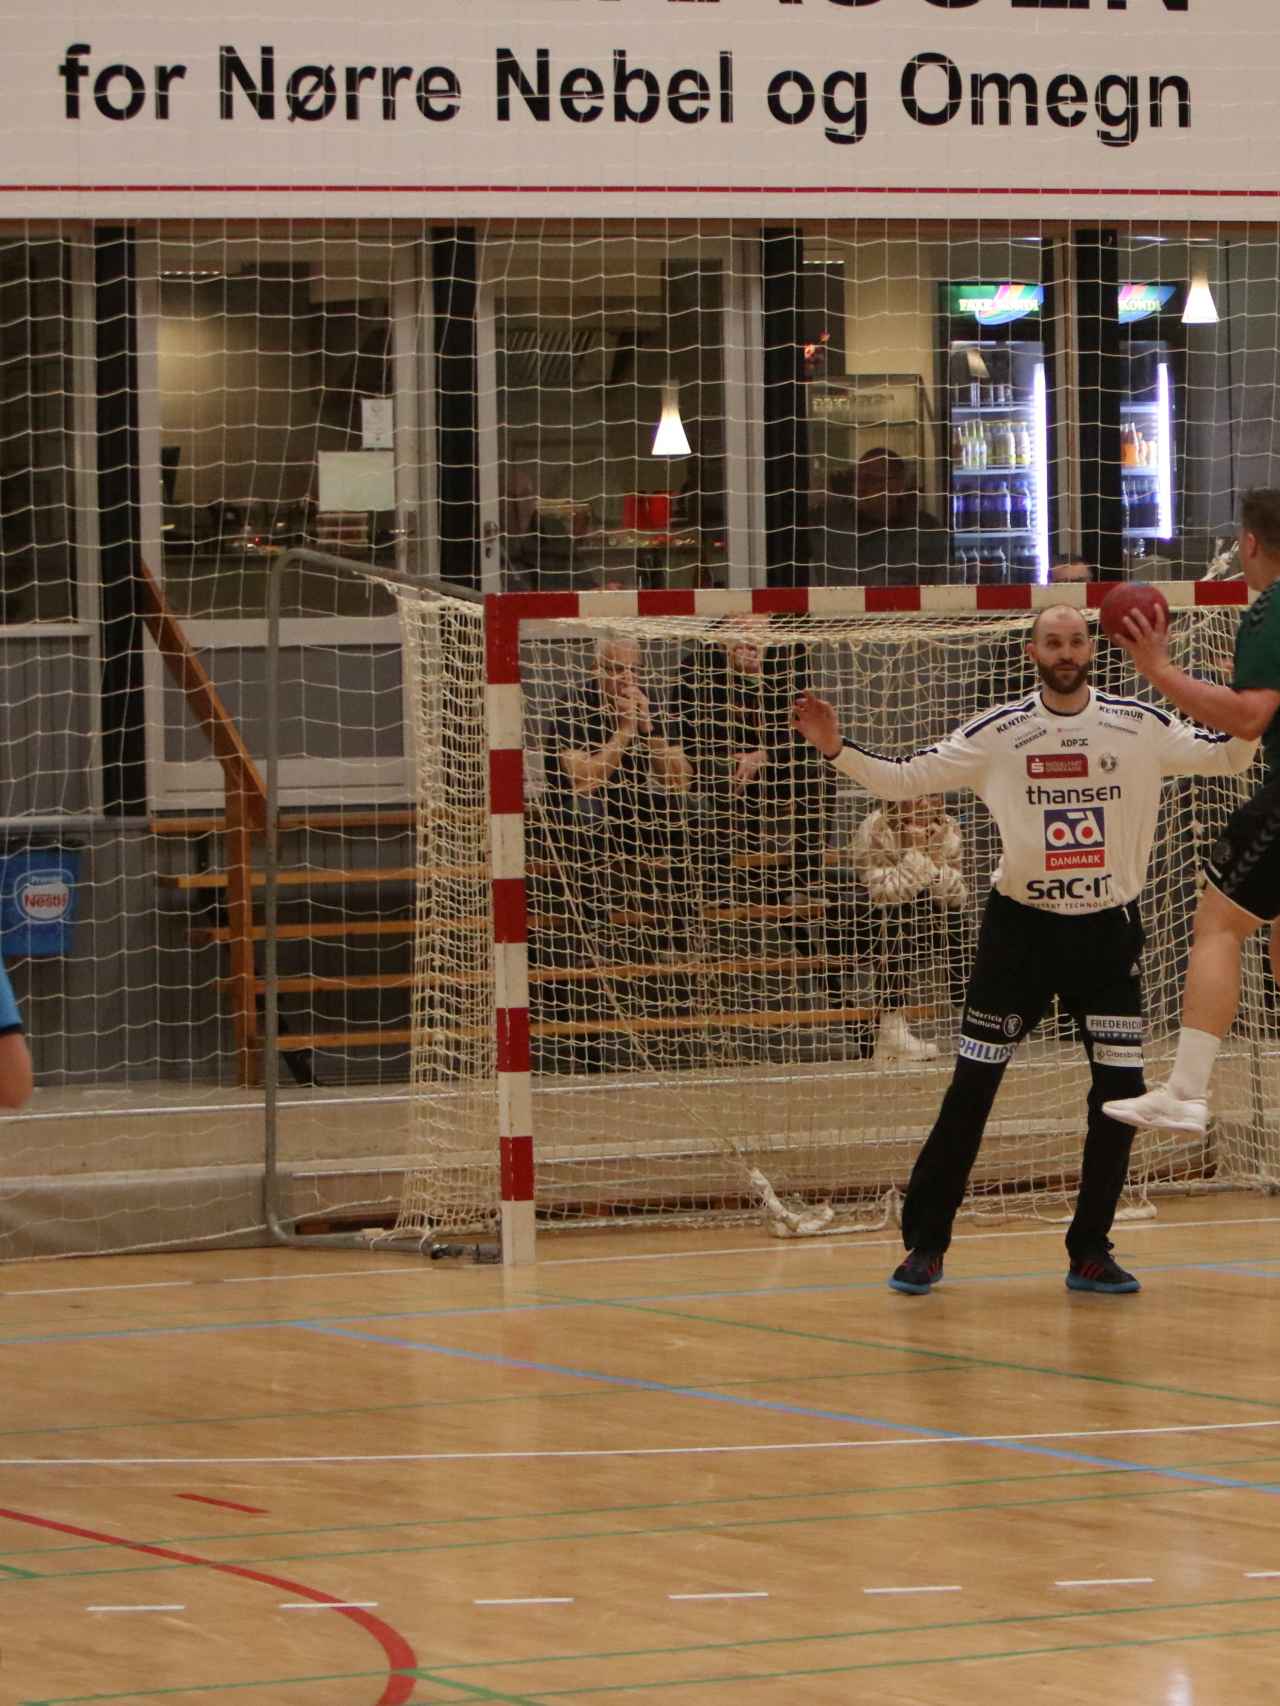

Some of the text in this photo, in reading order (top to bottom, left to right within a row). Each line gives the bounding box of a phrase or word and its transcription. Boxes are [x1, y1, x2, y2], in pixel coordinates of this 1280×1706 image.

[59, 44, 1191, 148] for Nørre Nebel og Omegn
[1026, 785, 1121, 805] thansen
[1050, 854, 1101, 867] DANMARK
[960, 1038, 1015, 1060] PHILIPS
